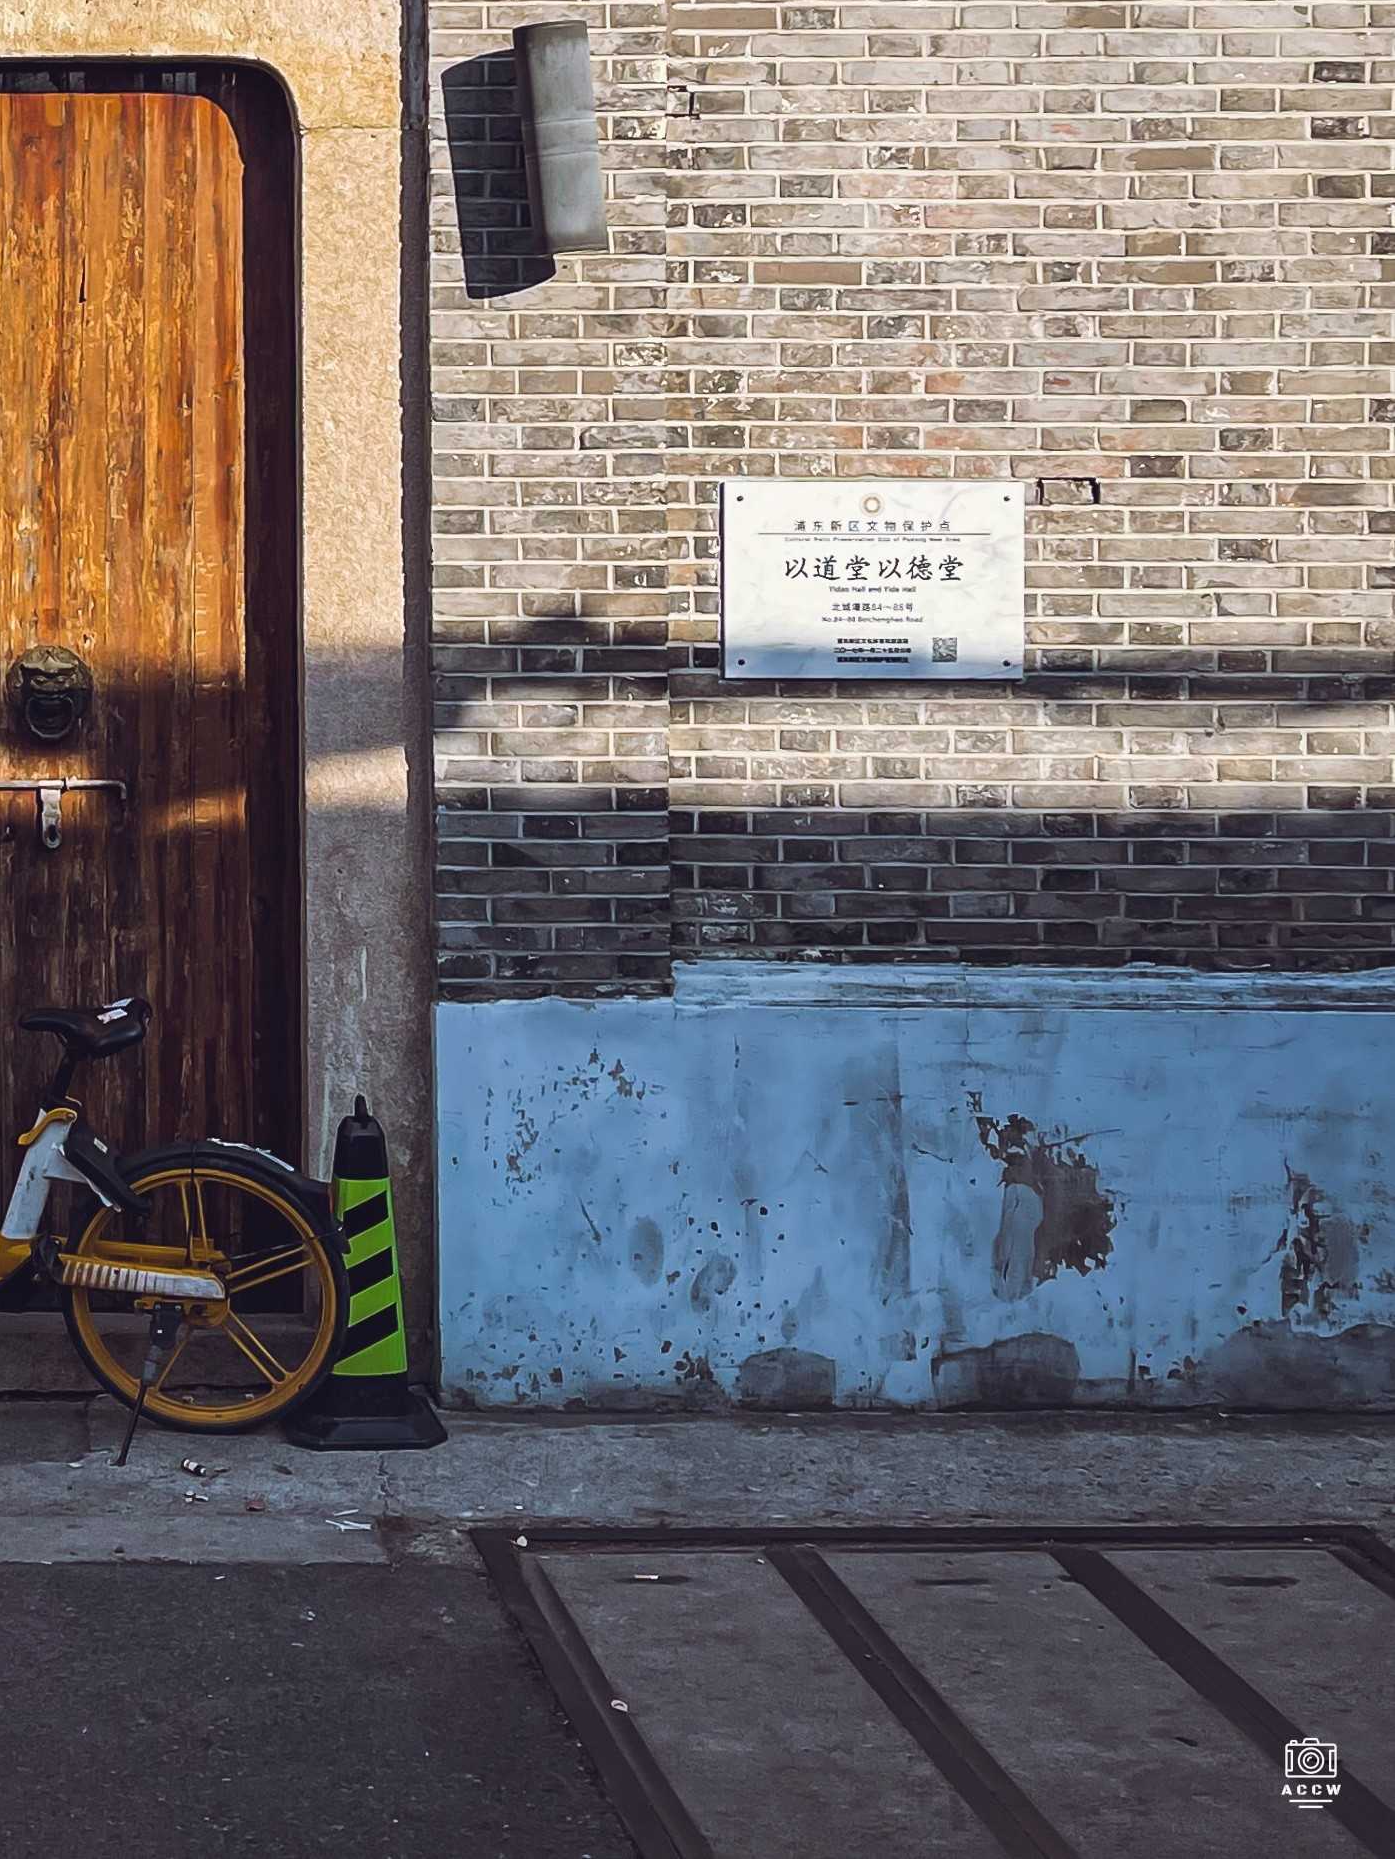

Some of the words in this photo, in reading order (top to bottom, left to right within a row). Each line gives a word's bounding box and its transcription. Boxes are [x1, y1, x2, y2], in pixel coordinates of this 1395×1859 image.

[784, 554, 964, 581] 以道堂以德堂
